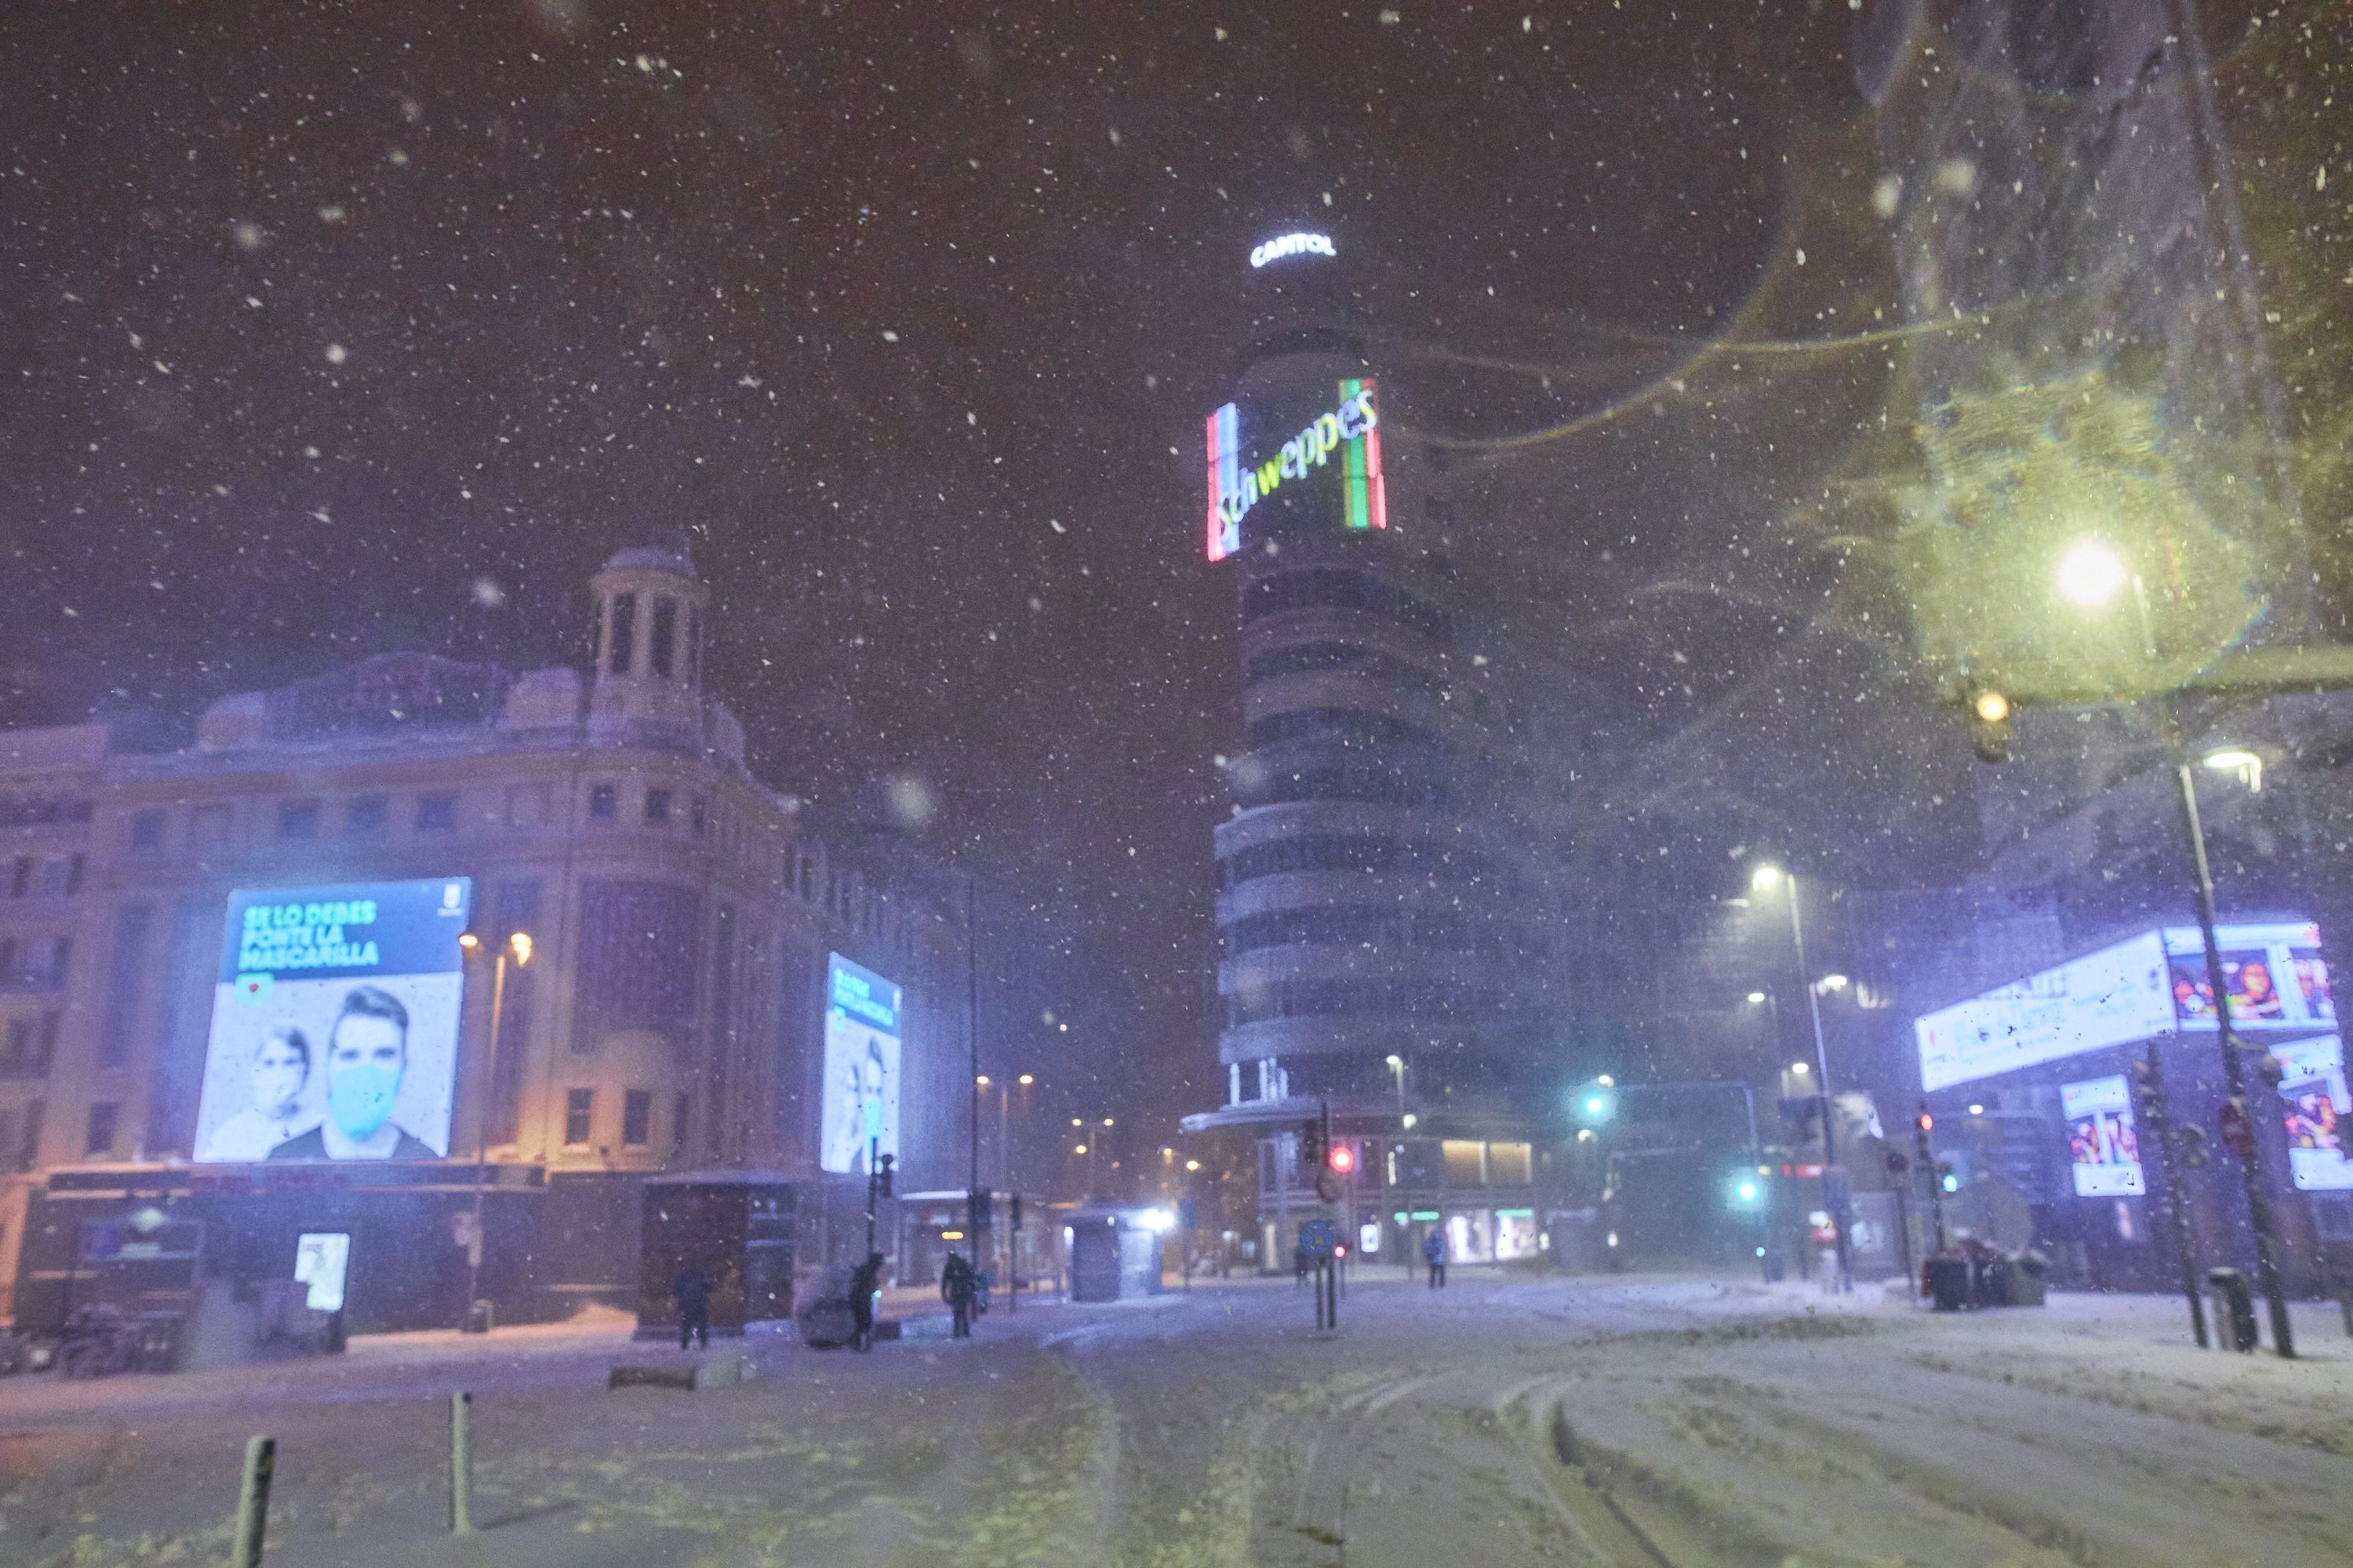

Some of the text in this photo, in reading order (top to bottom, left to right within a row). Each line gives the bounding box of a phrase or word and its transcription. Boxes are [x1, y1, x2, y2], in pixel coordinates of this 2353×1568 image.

[1220, 388, 1377, 543] Schweppes
[273, 903, 304, 927] LO
[304, 900, 376, 925] DEBES
[241, 924, 344, 949] PONTE LA
[238, 941, 379, 970] MASCARILLA
